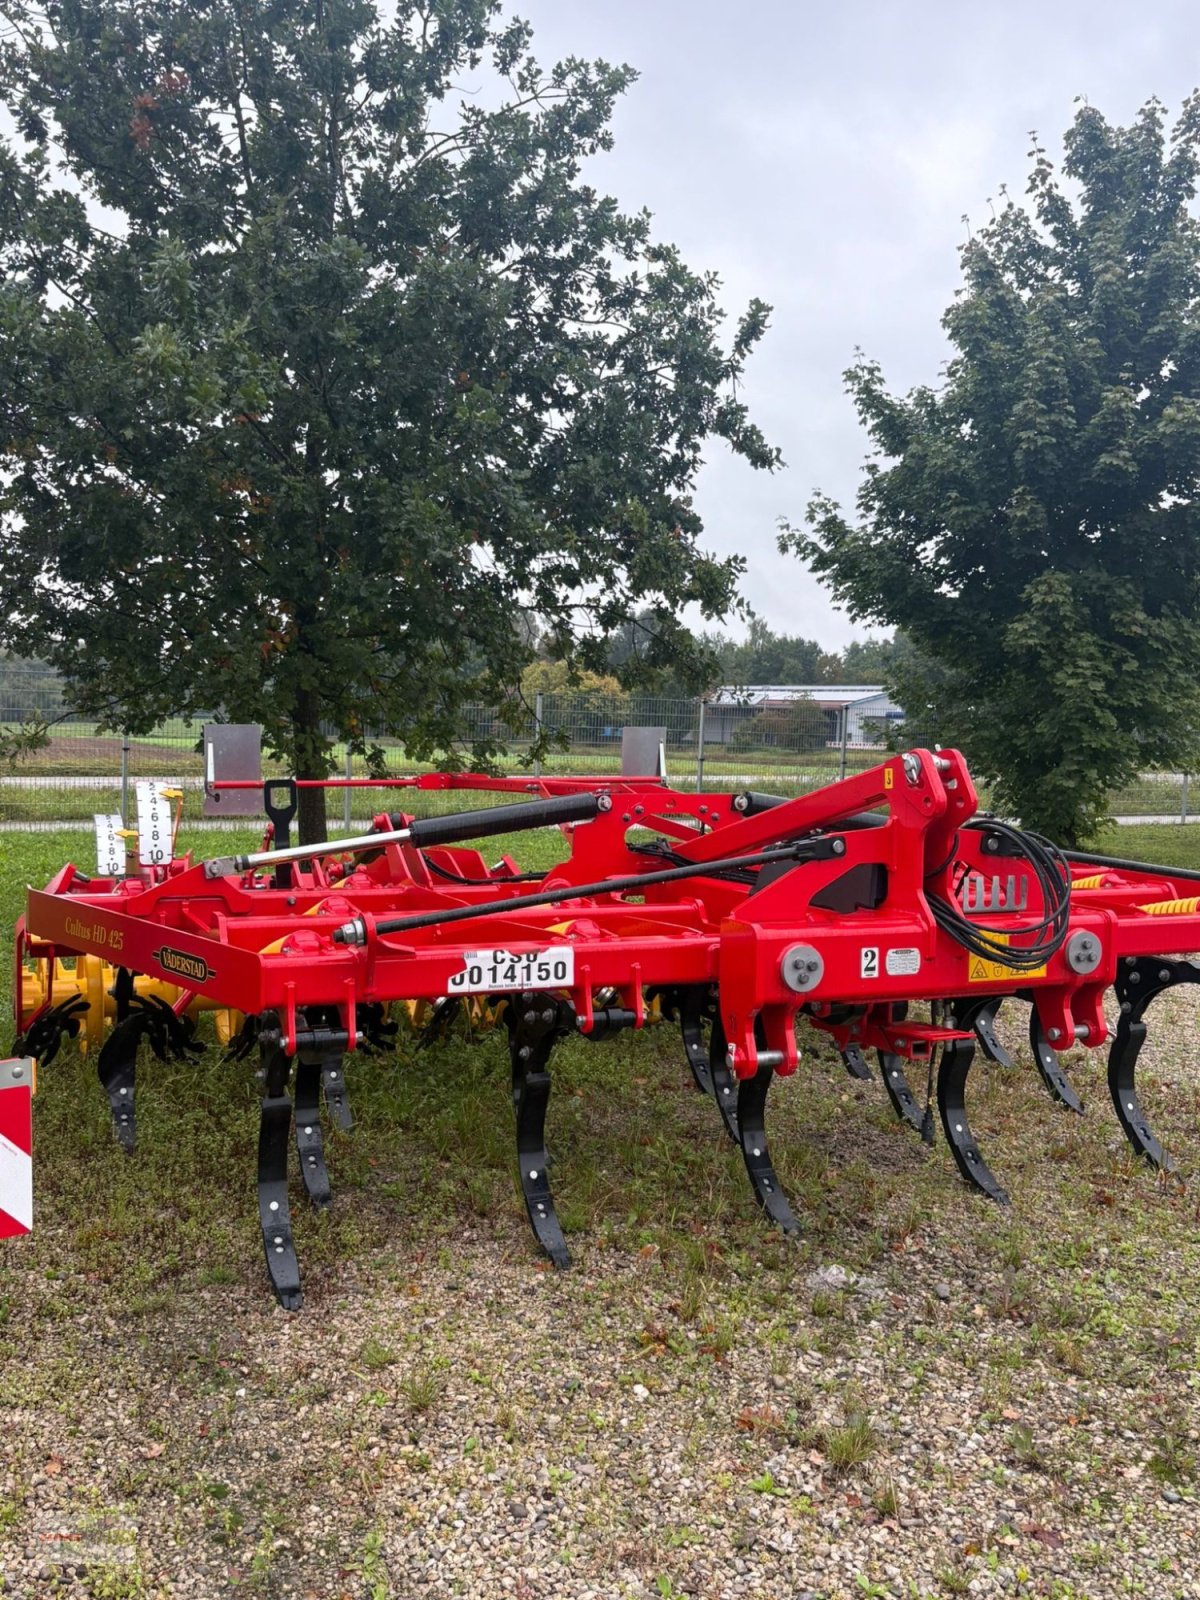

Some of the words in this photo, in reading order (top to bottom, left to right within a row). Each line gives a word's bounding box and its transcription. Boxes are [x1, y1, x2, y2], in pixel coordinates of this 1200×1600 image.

[150, 797, 158, 805] 4
[151, 812, 159, 822] 6
[108, 833, 115, 841] 6
[152, 830, 160, 841] 8
[109, 847, 116, 856] 8
[149, 849, 164, 861] 10
[106, 862, 119, 872] 10
[65, 916, 91, 941] Cultus
[92, 924, 107, 945] HD
[108, 929, 125, 951] 425
[162, 948, 205, 979] VÄDERSTAD
[863, 949, 876, 971] 2
